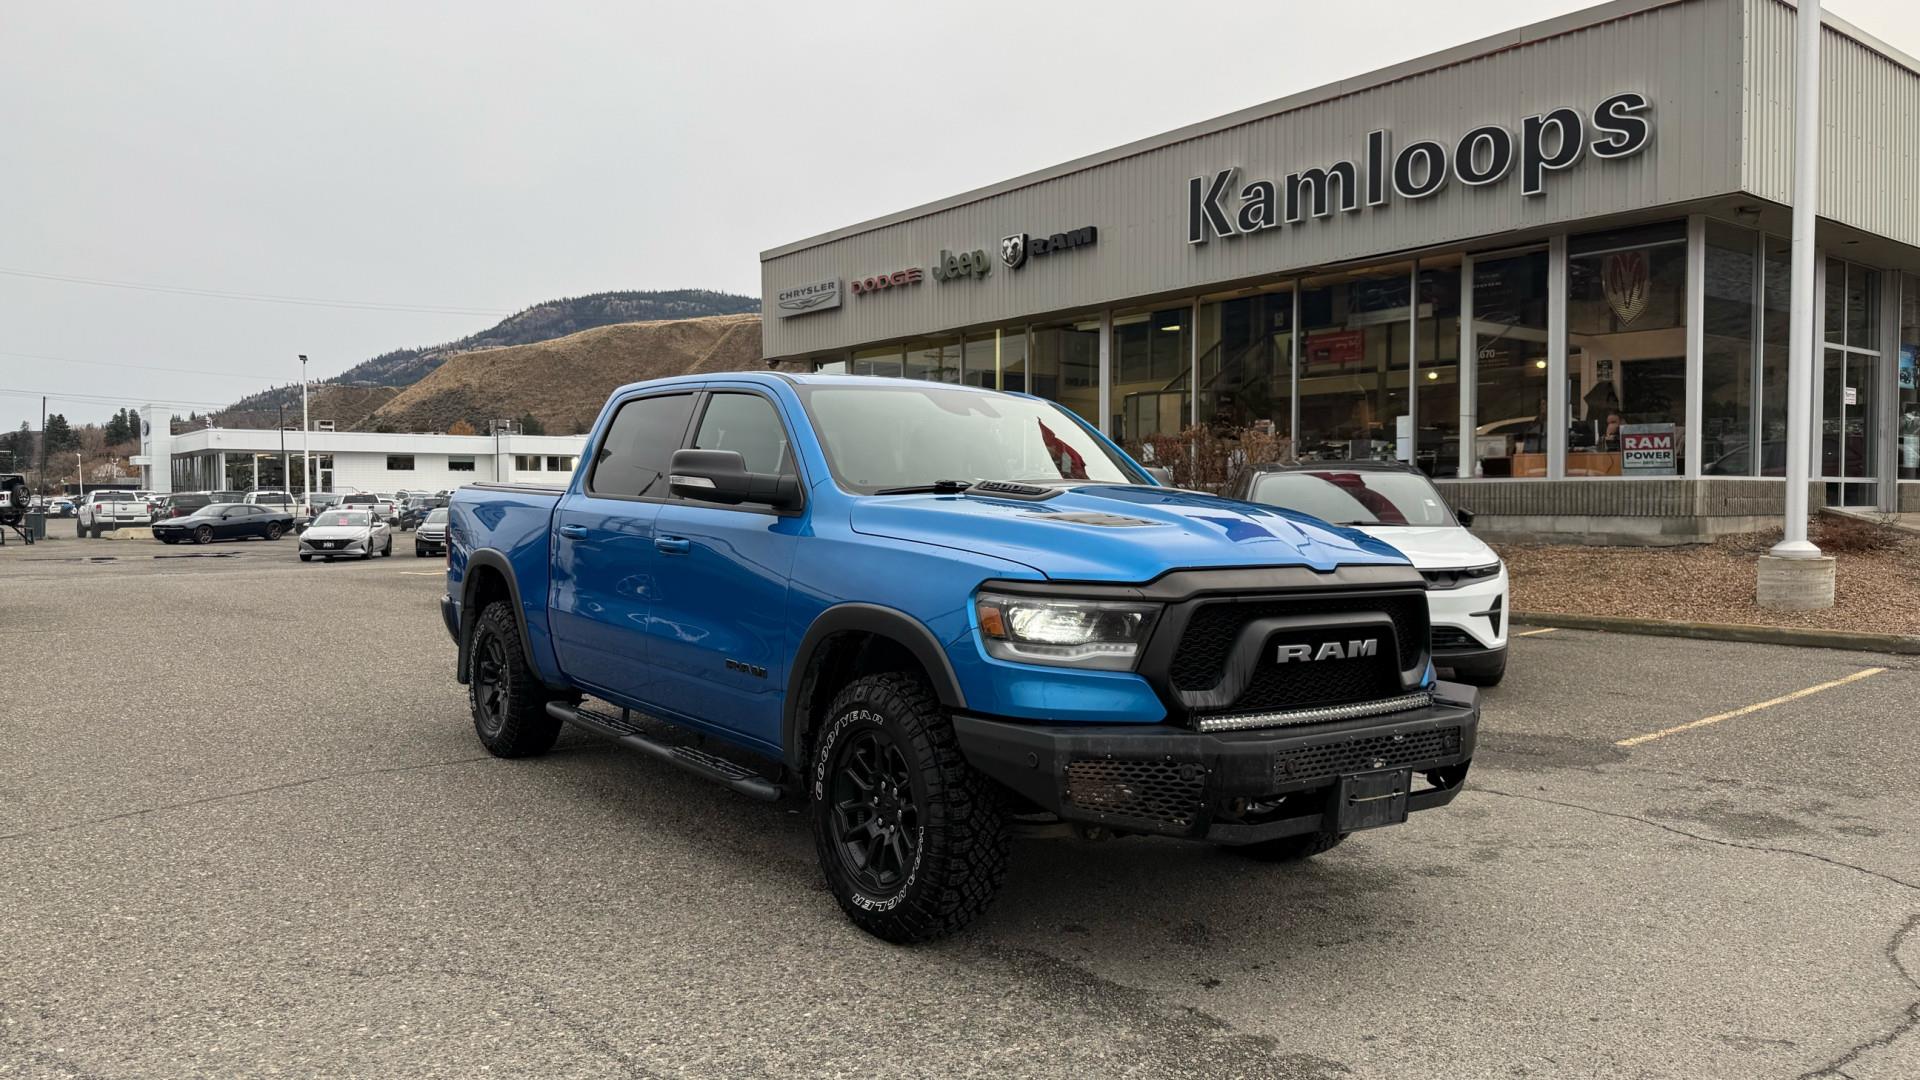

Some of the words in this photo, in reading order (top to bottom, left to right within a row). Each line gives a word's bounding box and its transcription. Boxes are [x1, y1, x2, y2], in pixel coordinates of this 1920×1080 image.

[1187, 91, 1653, 245] Kamloops
[1027, 226, 1098, 256] RAM
[932, 249, 991, 281] Jeep
[779, 281, 835, 301] CHRYSLER
[851, 267, 923, 295] DODGE
[1624, 436, 1671, 449] RAM
[1625, 451, 1671, 460] POWER
[1277, 638, 1378, 663] RAM
[725, 658, 768, 680] RAM
[815, 709, 884, 800] GOODYEAR
